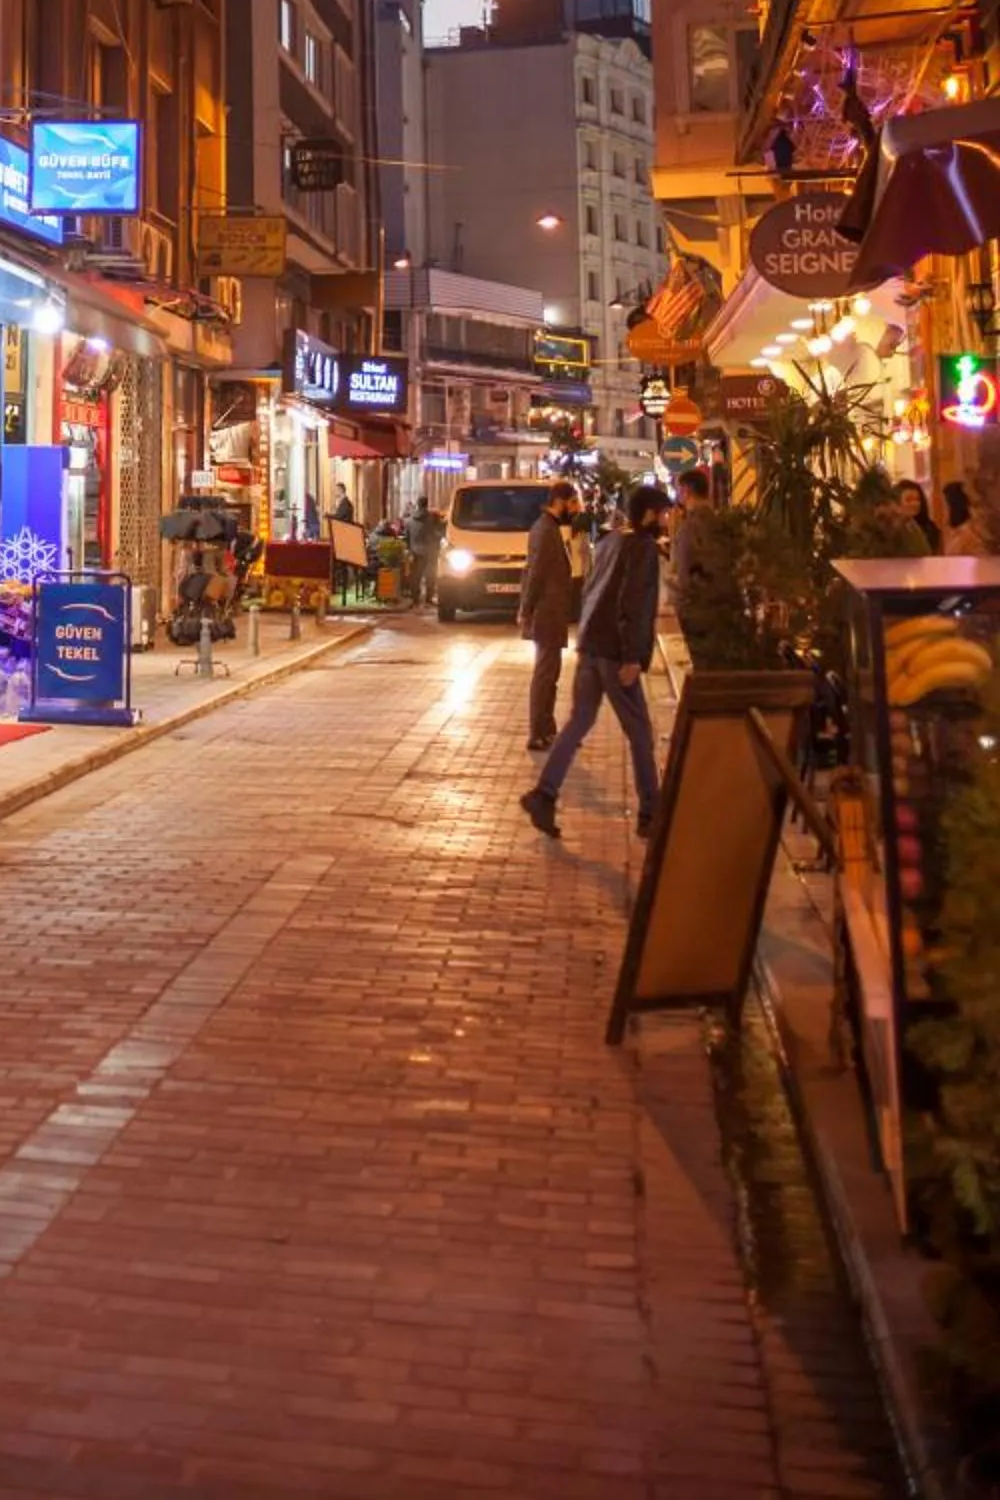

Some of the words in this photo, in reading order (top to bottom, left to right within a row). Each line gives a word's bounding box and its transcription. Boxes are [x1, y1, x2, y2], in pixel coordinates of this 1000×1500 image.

[38, 152, 87, 169] GÜVEN
[794, 203, 844, 223] Hote
[781, 228, 859, 249] GRAN
[764, 251, 858, 275] SEIGNE
[350, 373, 397, 391] SULTAN
[55, 623, 102, 640] GÜVEN
[56, 644, 100, 660] TEKEL
